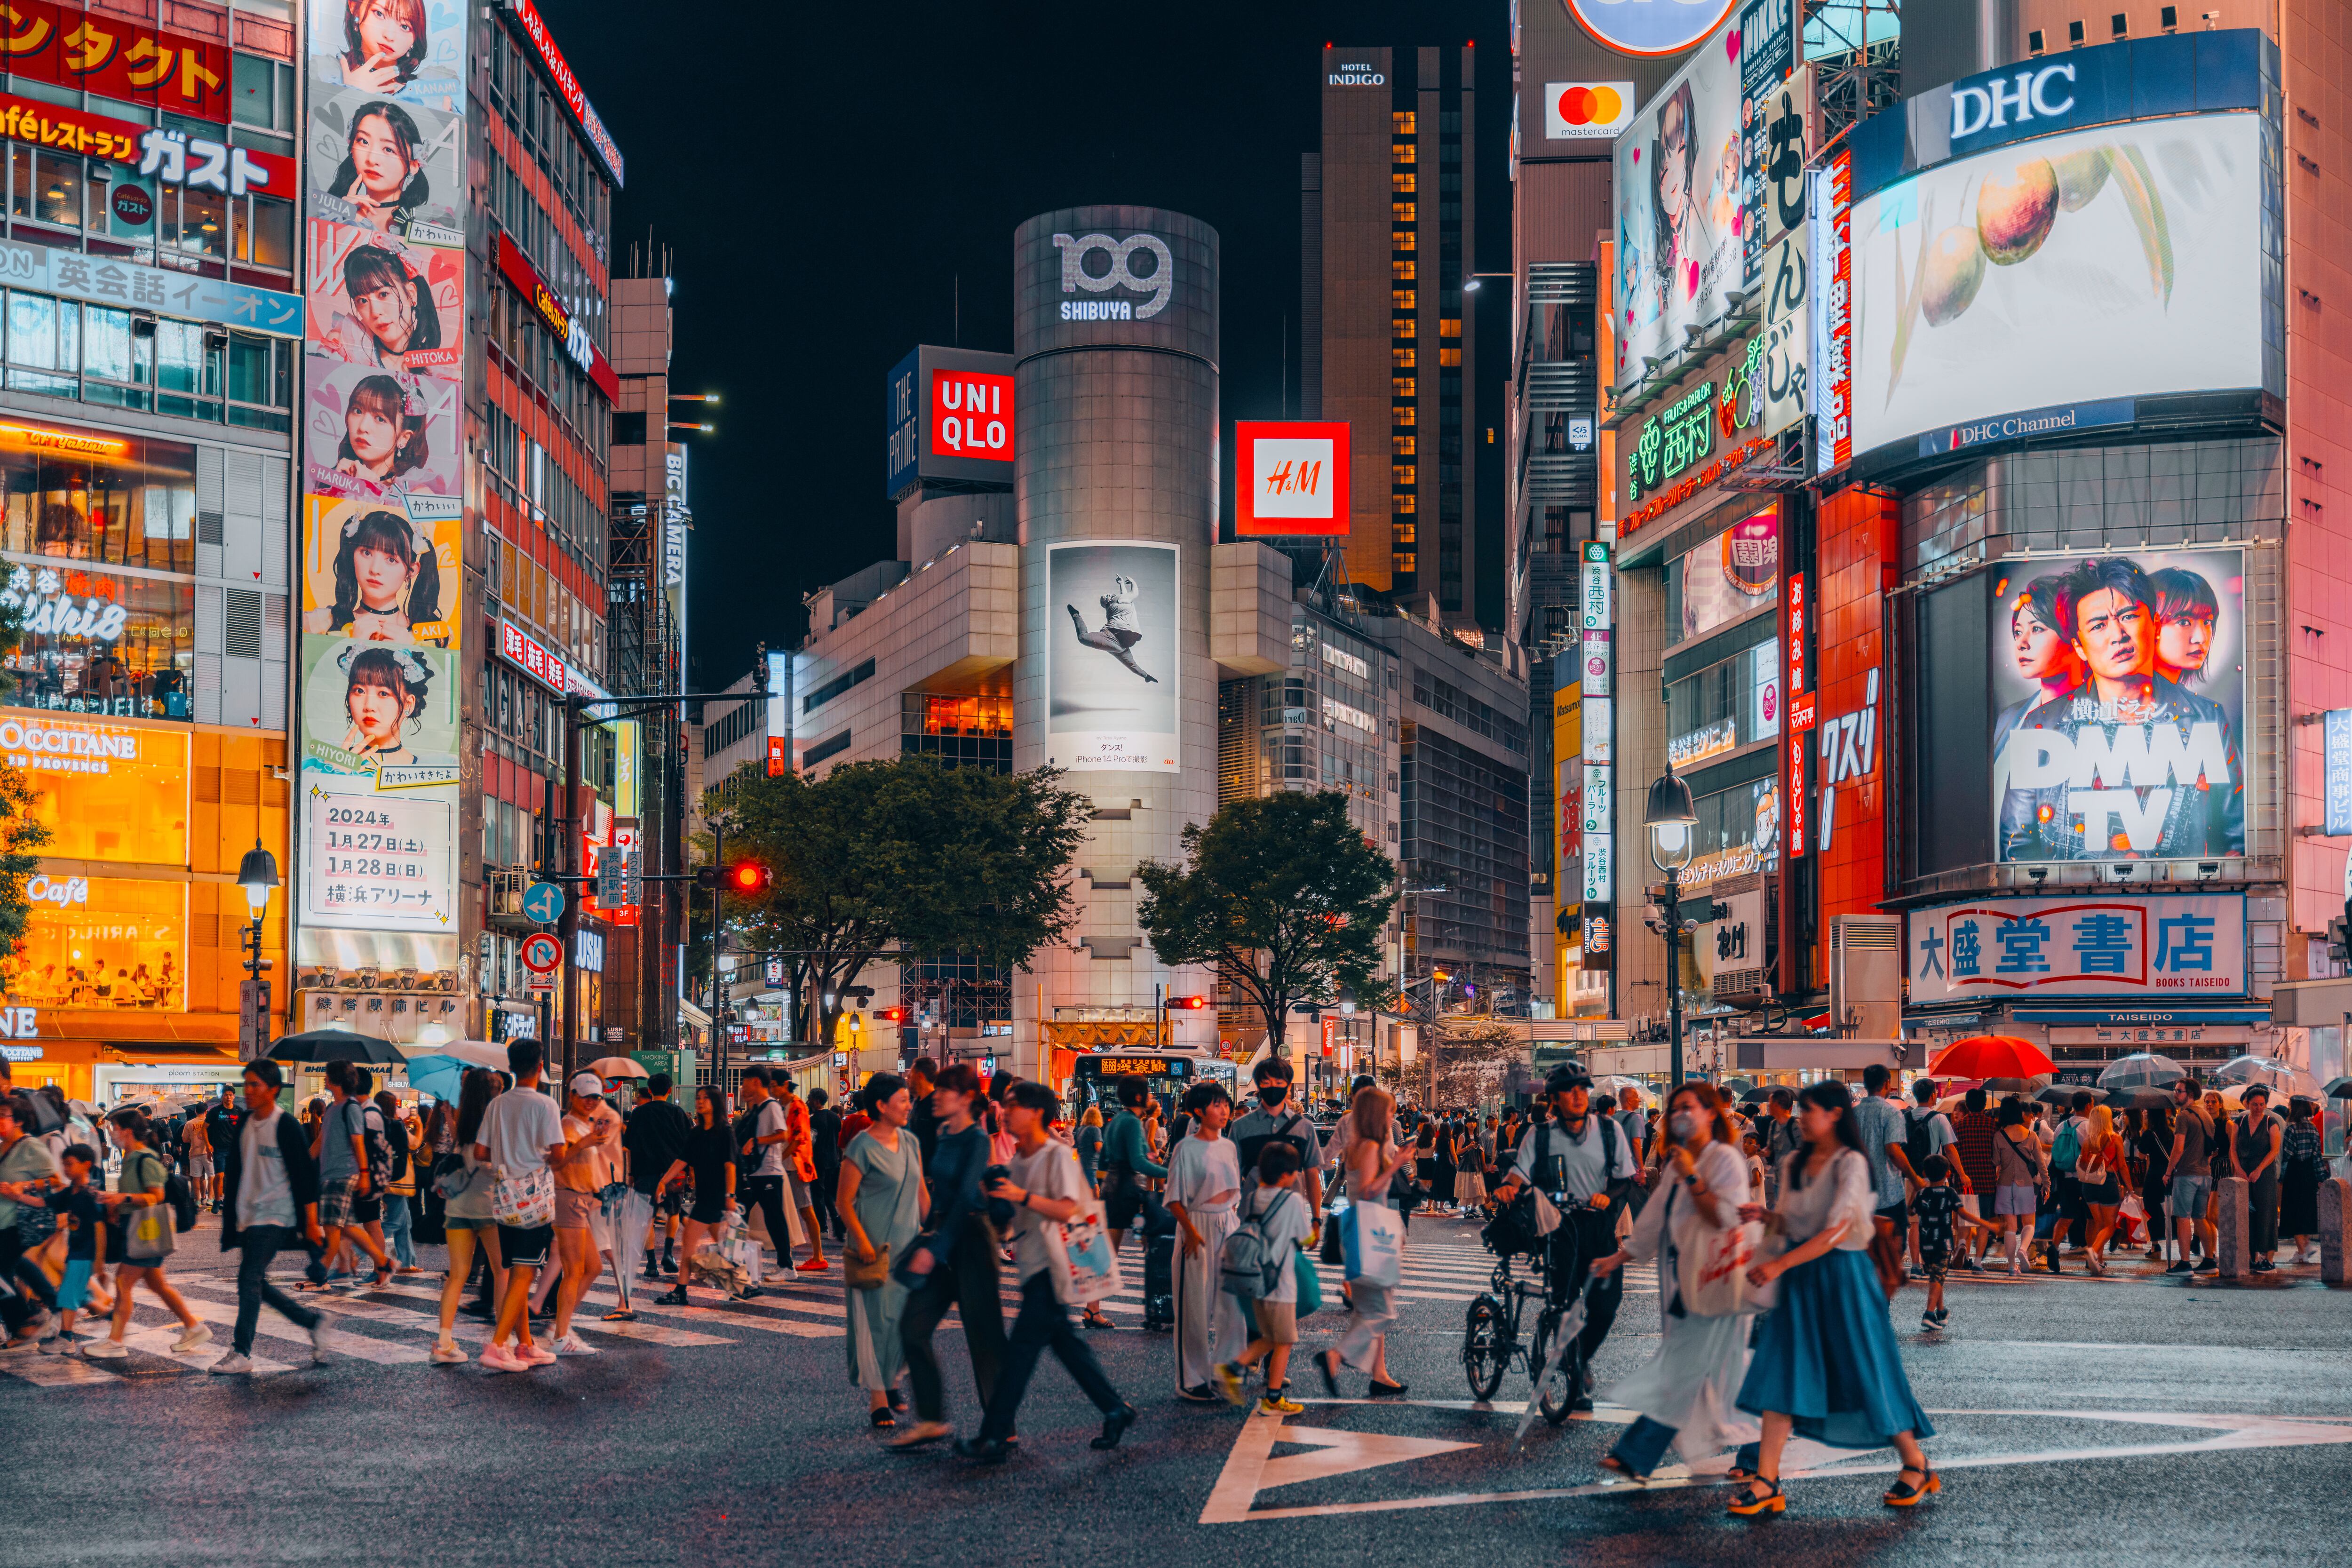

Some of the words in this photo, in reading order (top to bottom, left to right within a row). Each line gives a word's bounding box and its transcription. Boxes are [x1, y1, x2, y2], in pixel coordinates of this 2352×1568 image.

[414, 81, 457, 95] KANAMI
[1329, 74, 1384, 85] INDIGO
[1951, 64, 2075, 140] DHC
[1561, 127, 1620, 136] mastercard
[140, 128, 270, 196] ガスト
[117, 200, 149, 215] ガスト
[318, 194, 351, 217] JULIA
[413, 226, 458, 242] かわいい
[1767, 91, 1808, 412] もんじゃ
[57, 255, 295, 325] 英会話イーオン
[1053, 233, 1173, 319] 109
[1060, 301, 1131, 320] SHIBUYA
[411, 351, 454, 366] HITOKA
[567, 317, 594, 373] ガスト
[895, 371, 911, 426] THE
[943, 380, 1001, 415] UNI
[942, 416, 1005, 451] QLO
[1663, 405, 1712, 479] 西村
[1961, 422, 2000, 446] DHC
[2002, 410, 2076, 438] Channel
[889, 416, 916, 479] PRIME
[317, 469, 361, 494] HARUKA
[666, 454, 682, 491] BIC
[1266, 459, 1321, 496] H&M
[413, 499, 457, 512] かわいい
[66, 572, 116, 602] 焼肉
[1588, 566, 1605, 614] 渋谷西村
[421, 625, 442, 637] AKI
[1590, 632, 1603, 641] 4F
[1792, 581, 1802, 691] お好み焼
[505, 626, 524, 662] 薄毛
[527, 642, 544, 677] 抜毛
[548, 655, 563, 689] 発毛
[1791, 701, 1800, 712] 渋谷
[34, 756, 110, 774] PROVENCE
[316, 744, 357, 767] HIYORI
[620, 753, 629, 783] レイク
[2010, 723, 2230, 789] DMM
[384, 768, 452, 783] かわいすぎたよ
[2331, 716, 2350, 830] 大盛堂商事ビル
[1587, 784, 1597, 817] パーラー
[1597, 780, 1607, 813] フルーツ
[1792, 740, 1802, 852] もんじゃ焼
[329, 807, 390, 827] 2024年
[2068, 789, 2173, 851] TV
[329, 831, 424, 854] 1月27日(土)
[329, 857, 423, 879] 1月28日(日)
[608, 852, 620, 904] 渋谷駅前
[629, 853, 638, 903] スクランブル式
[1587, 852, 1597, 886] フルーツ
[1597, 848, 1607, 883] 渋谷西村
[27, 875, 88, 909] Café
[326, 884, 433, 907] 横浜アリーナ
[575, 929, 602, 972] USH
[1589, 917, 1609, 953] HUB
[1919, 913, 2216, 982] 大盛堂書店
[2156, 978, 2186, 987] BOOKS
[2189, 978, 2230, 987] TAISEIDO
[241, 988, 251, 1054] 道玄坂
[317, 996, 455, 1013] 渋谷駅前ビル
[504, 1013, 535, 1039] ンドラッグ
[2120, 1028, 2201, 1041] 大盛堂書店
[168, 1069, 191, 1078] ploom
[1116, 1063, 1167, 1072] 渋谷駅
